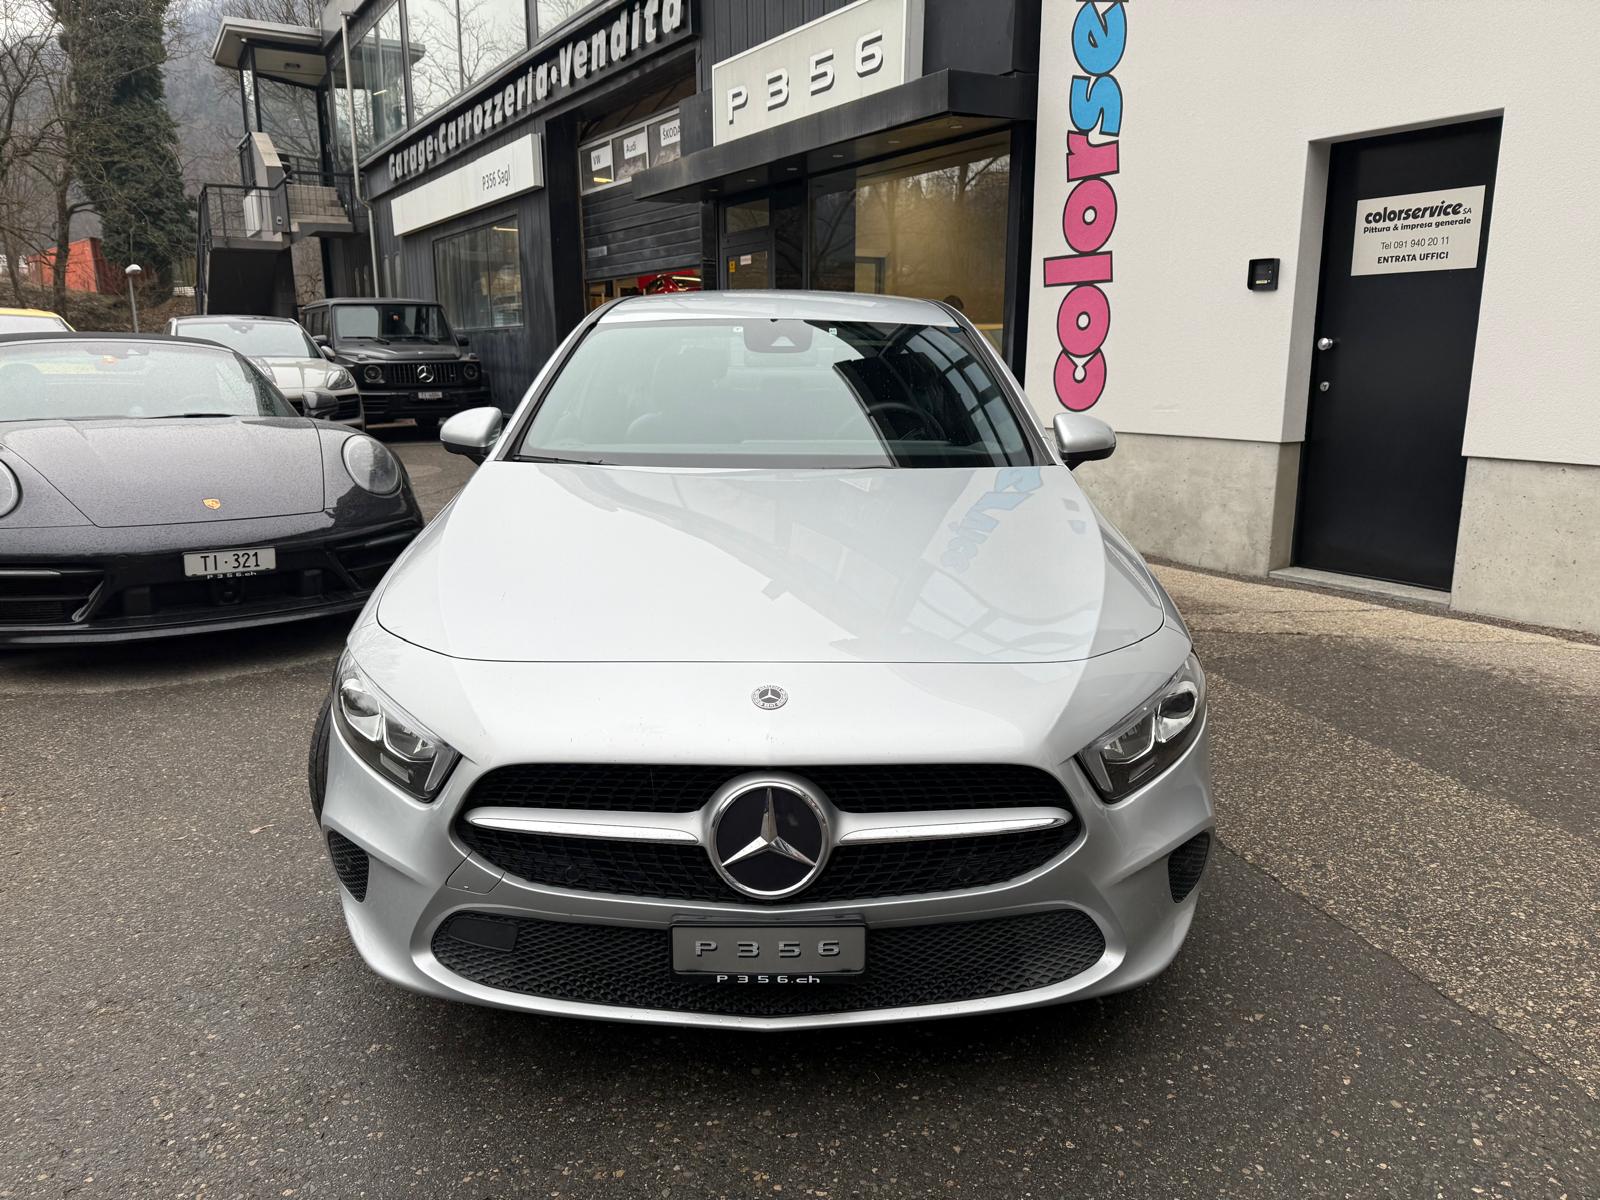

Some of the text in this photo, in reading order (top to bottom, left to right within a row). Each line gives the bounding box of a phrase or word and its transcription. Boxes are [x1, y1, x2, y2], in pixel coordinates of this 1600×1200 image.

[593, 152, 601, 166] VW
[482, 164, 511, 191] P356 Sagl
[1364, 200, 1472, 224] colorservice SA
[1363, 226, 1391, 234] Pittura
[1401, 222, 1433, 231] impresa
[1435, 217, 1471, 228] generale
[1381, 236, 1449, 250] Tel 091 940 20 11
[1377, 251, 1449, 264] ENTRATA UFFICI
